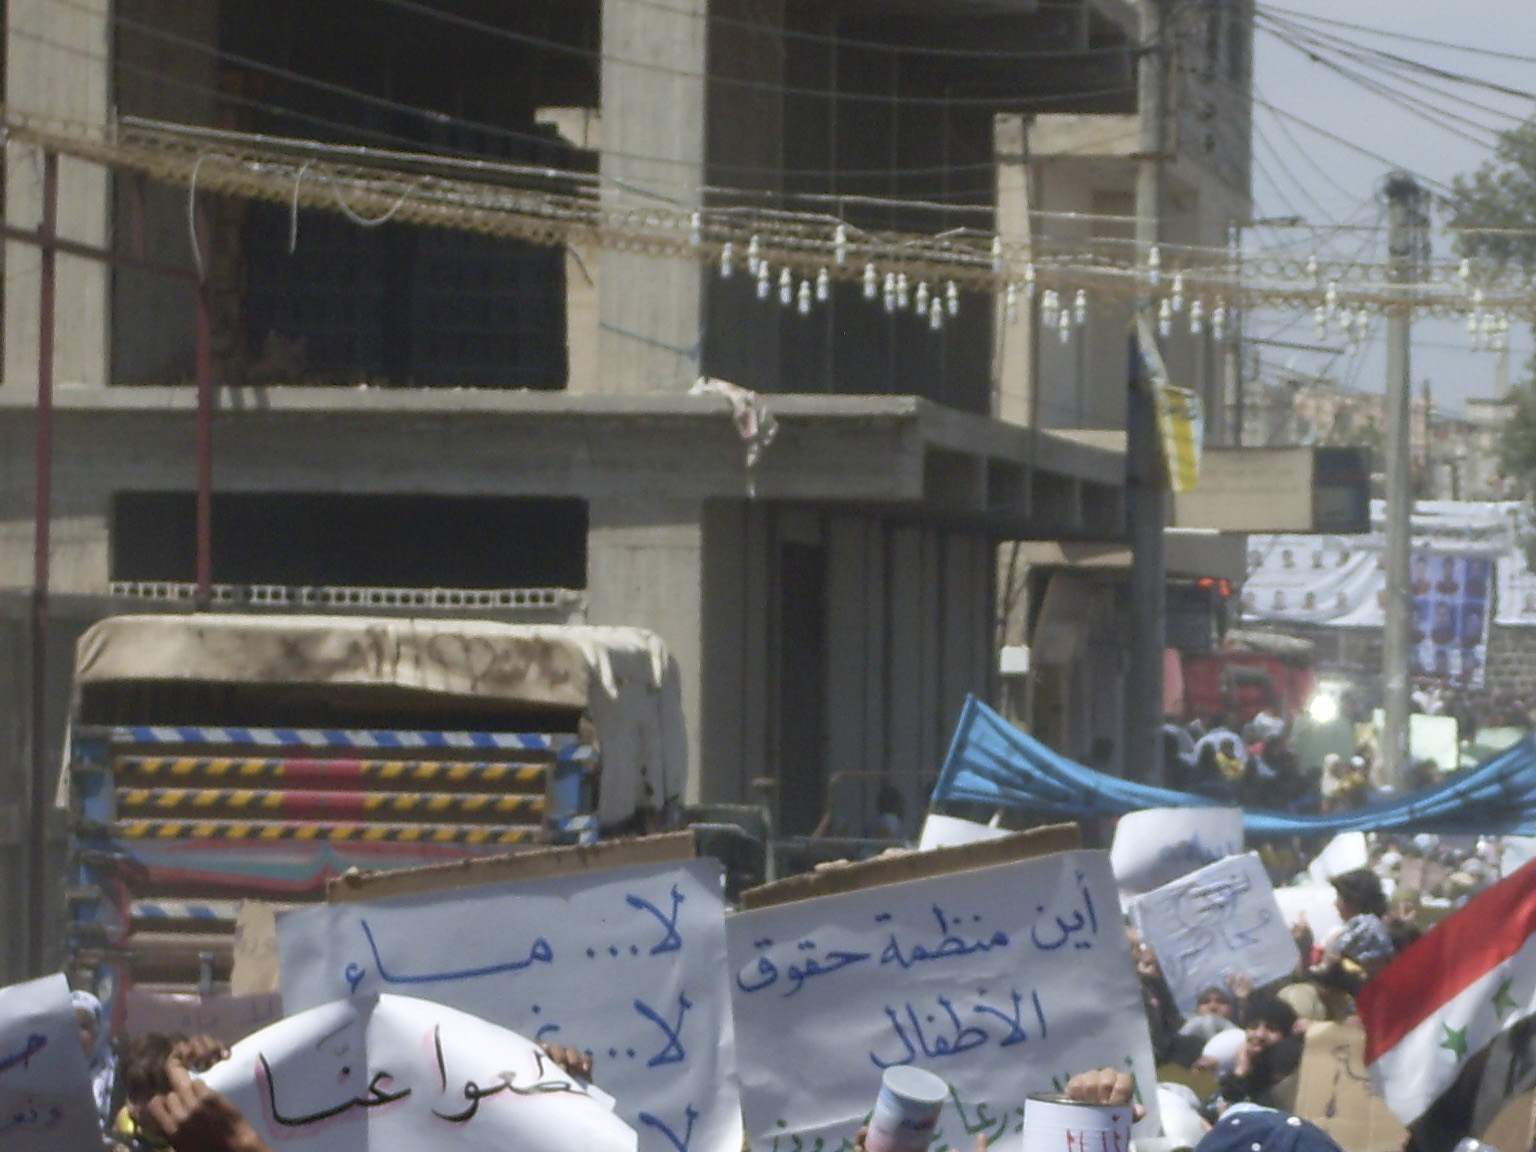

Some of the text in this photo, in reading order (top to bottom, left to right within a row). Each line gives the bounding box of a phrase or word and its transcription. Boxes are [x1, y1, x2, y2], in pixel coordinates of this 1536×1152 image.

[875, 903, 1009, 970] منظمة
[1031, 871, 1099, 952] أين
[736, 938, 870, 997] حقوق
